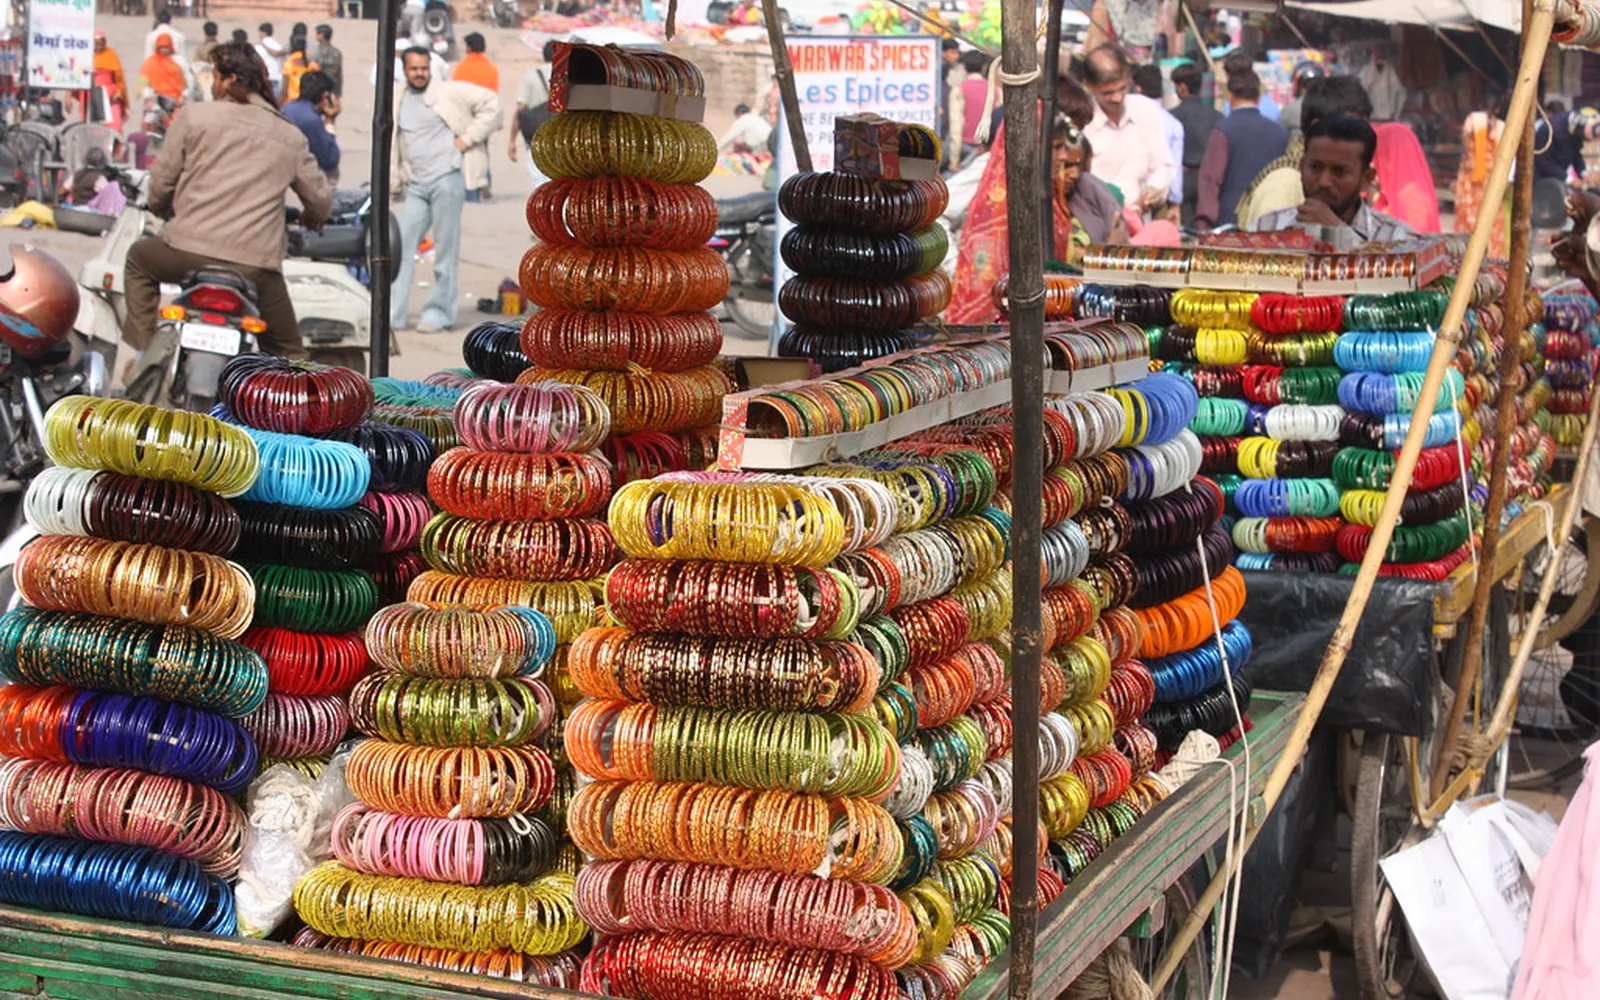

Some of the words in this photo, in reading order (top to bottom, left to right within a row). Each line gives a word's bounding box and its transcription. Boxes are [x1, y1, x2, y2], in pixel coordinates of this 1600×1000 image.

[788, 44, 865, 72] MARWAR
[869, 43, 930, 72] SPICES
[798, 83, 838, 104] es
[845, 77, 930, 108] Epices
